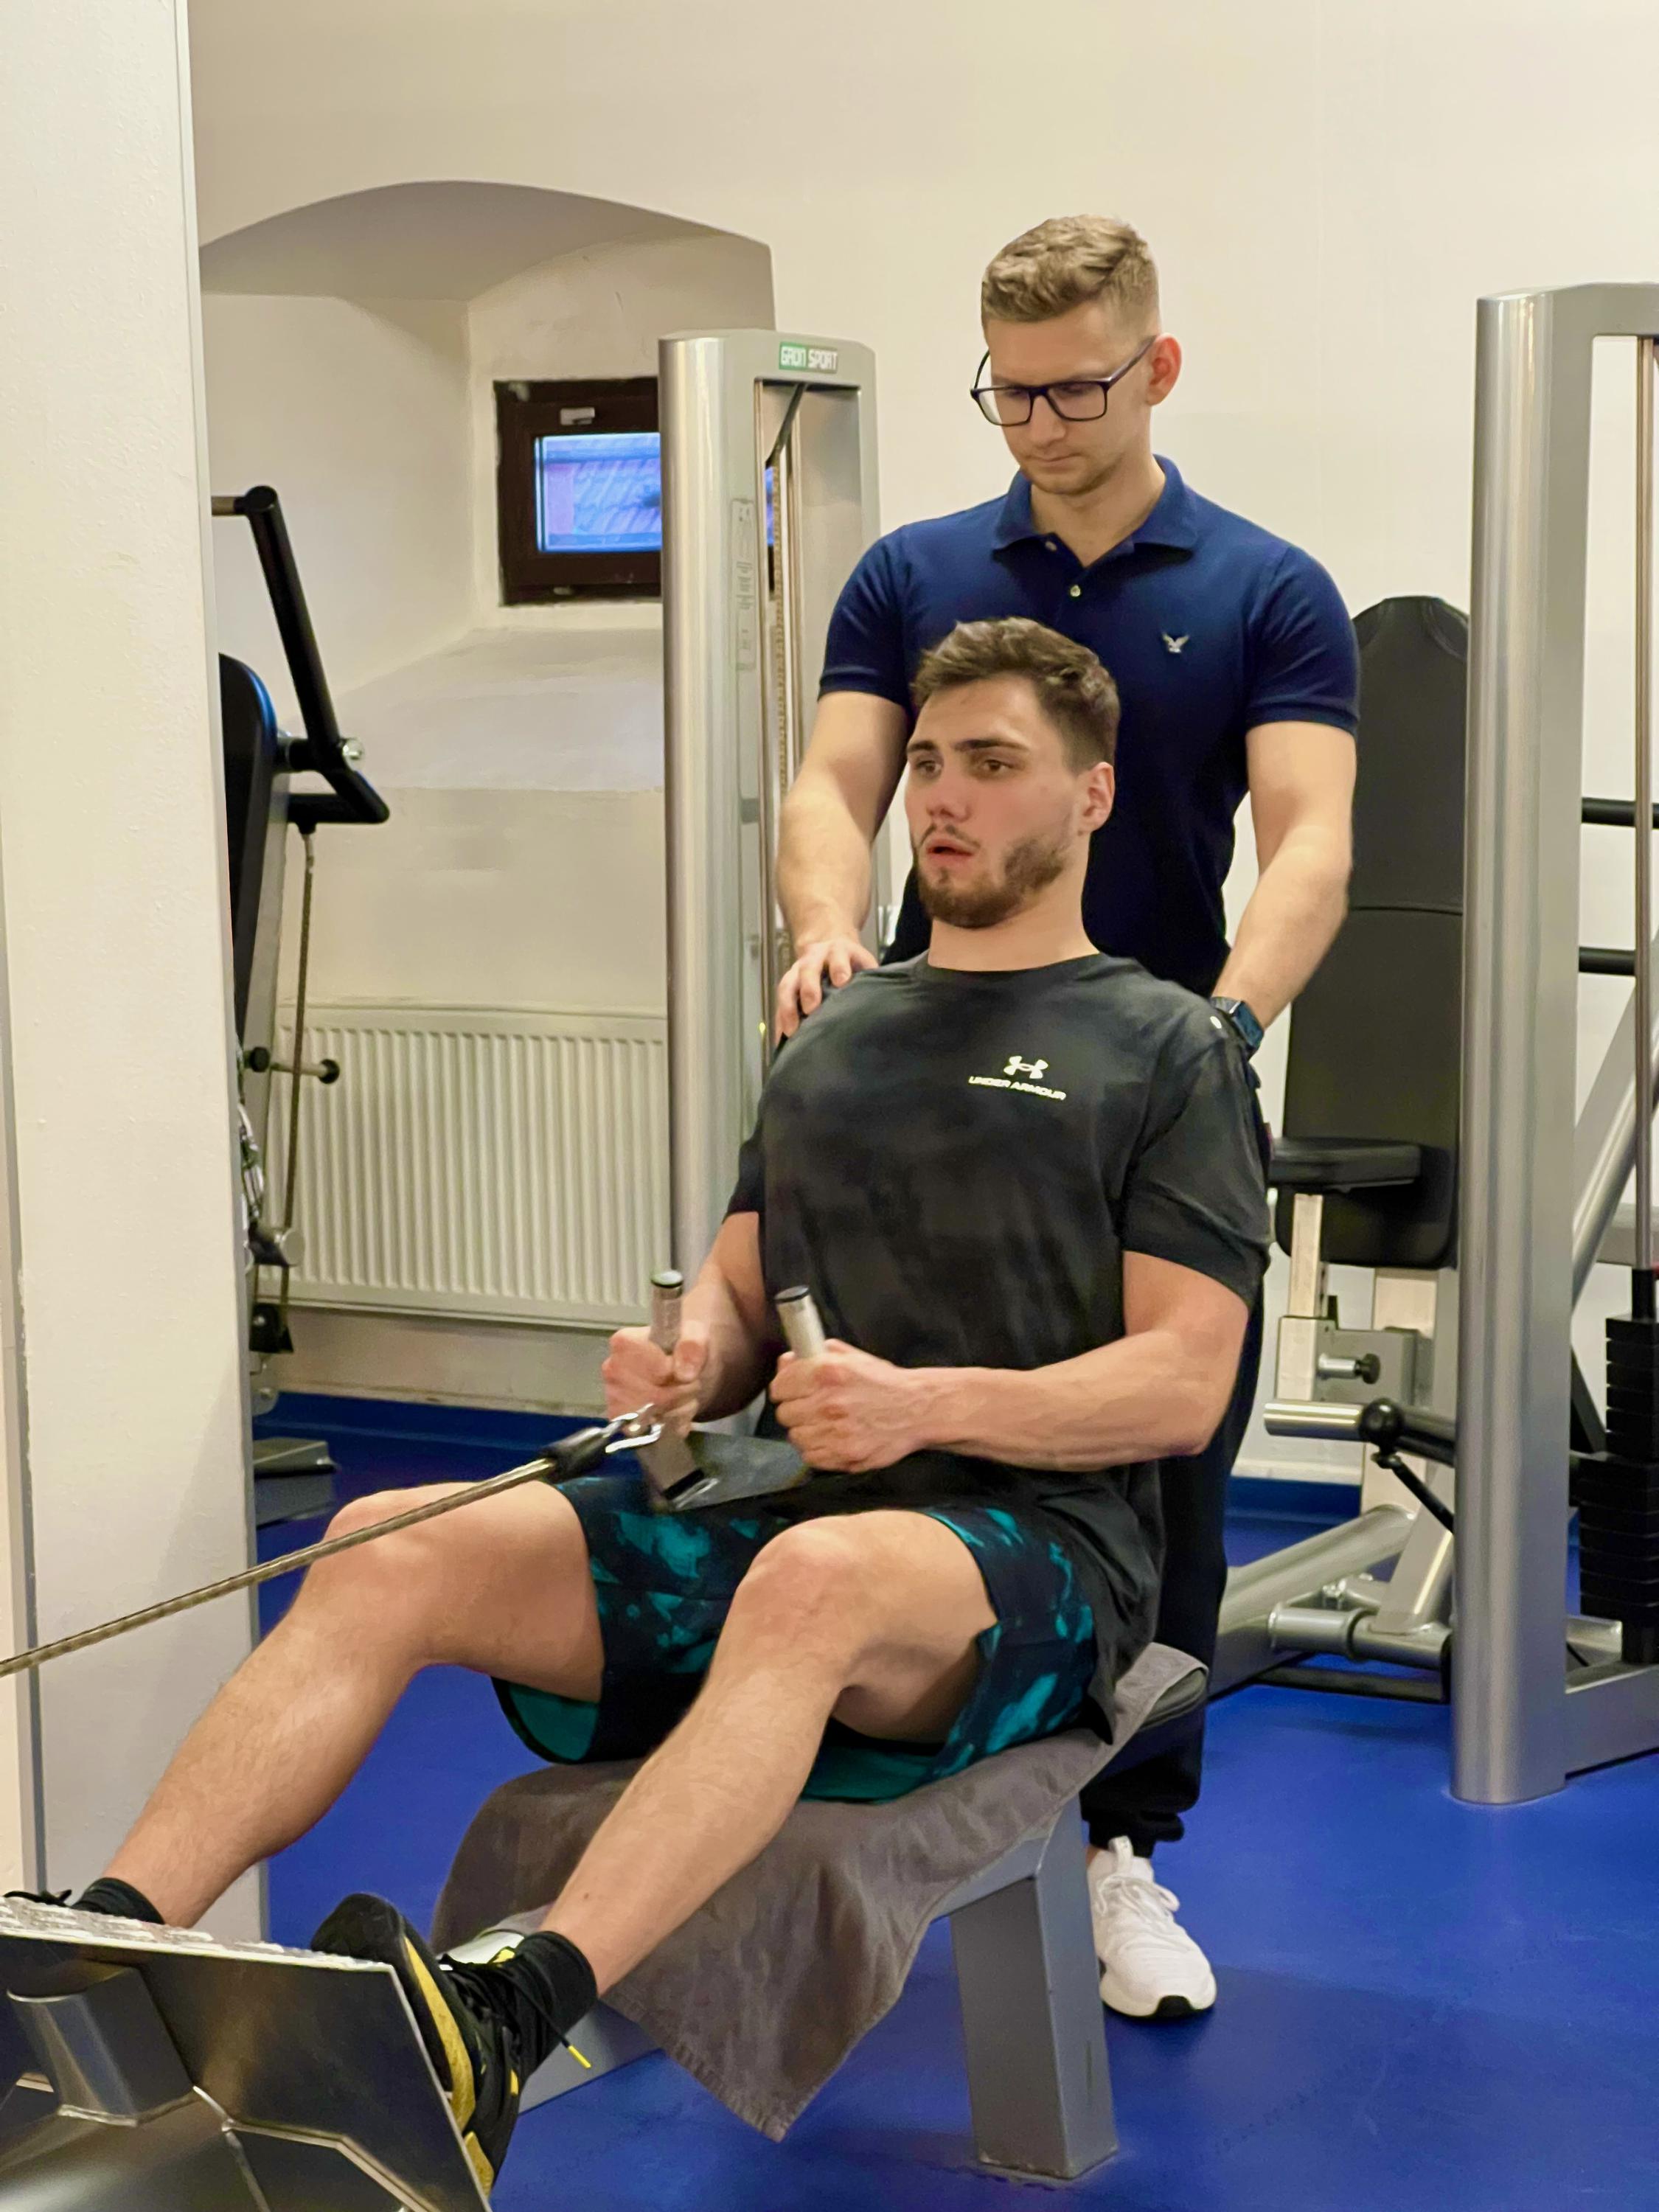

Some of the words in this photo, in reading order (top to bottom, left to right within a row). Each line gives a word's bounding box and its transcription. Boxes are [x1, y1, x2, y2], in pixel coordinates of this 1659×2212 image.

[808, 348, 838, 371] SPORT
[968, 1076, 1011, 1088] UNDER
[1010, 1082, 1066, 1100] ARMOUR
